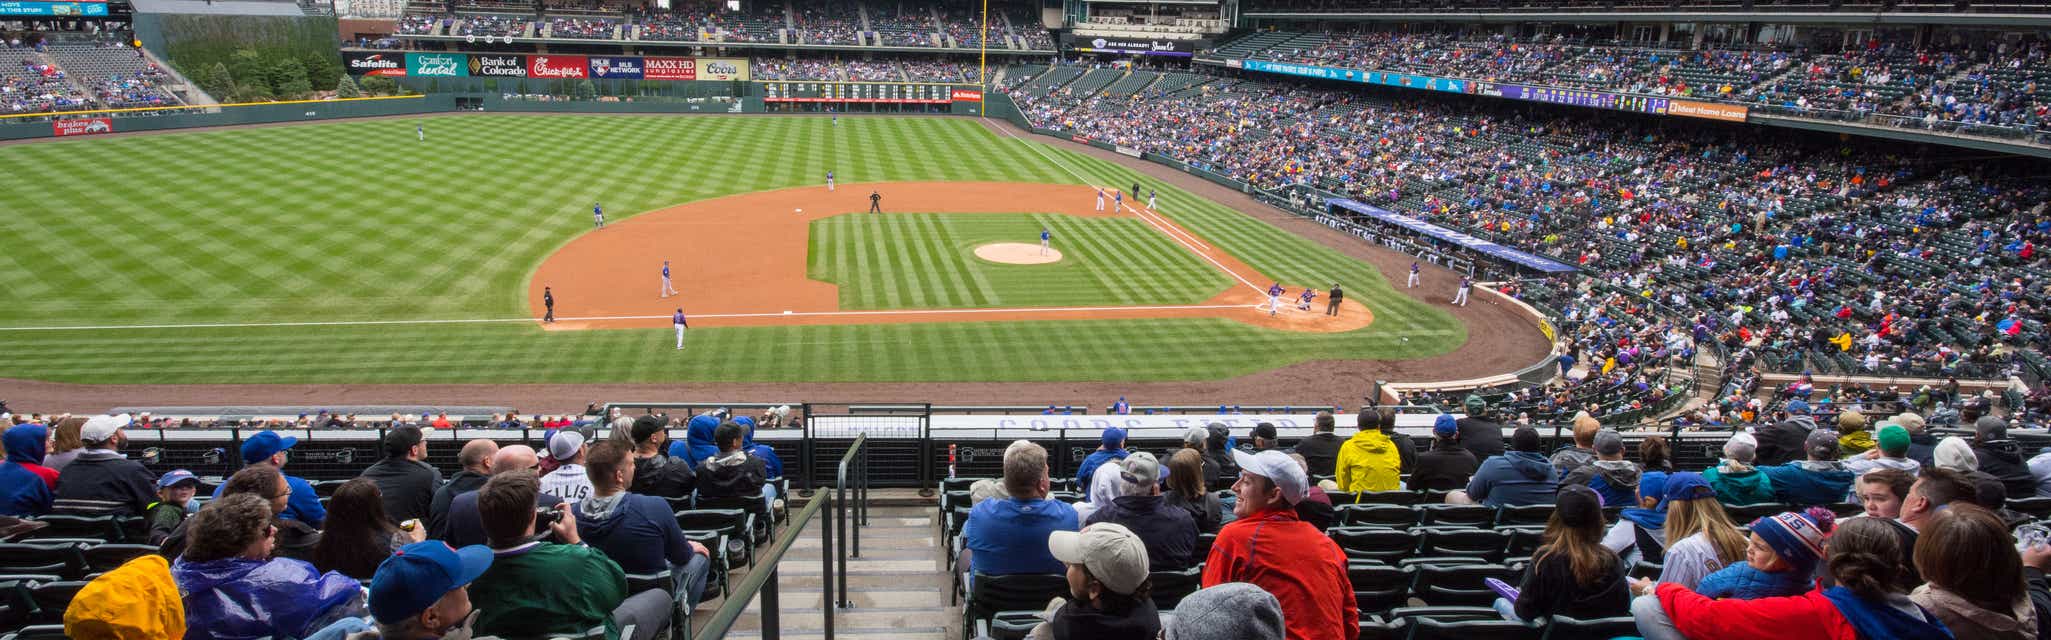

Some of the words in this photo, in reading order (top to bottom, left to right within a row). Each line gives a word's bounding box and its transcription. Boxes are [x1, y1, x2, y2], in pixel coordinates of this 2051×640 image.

[351, 59, 398, 68] Safelite
[418, 54, 453, 65] Comfort
[481, 57, 505, 66] Bank
[506, 57, 517, 65] of
[418, 62, 457, 75] dental
[646, 60, 677, 69] MAXX
[678, 60, 694, 69] HD
[706, 62, 737, 74] Coors
[482, 65, 526, 75] Colorado
[57, 120, 88, 128] brakes
[64, 127, 83, 135] plus
